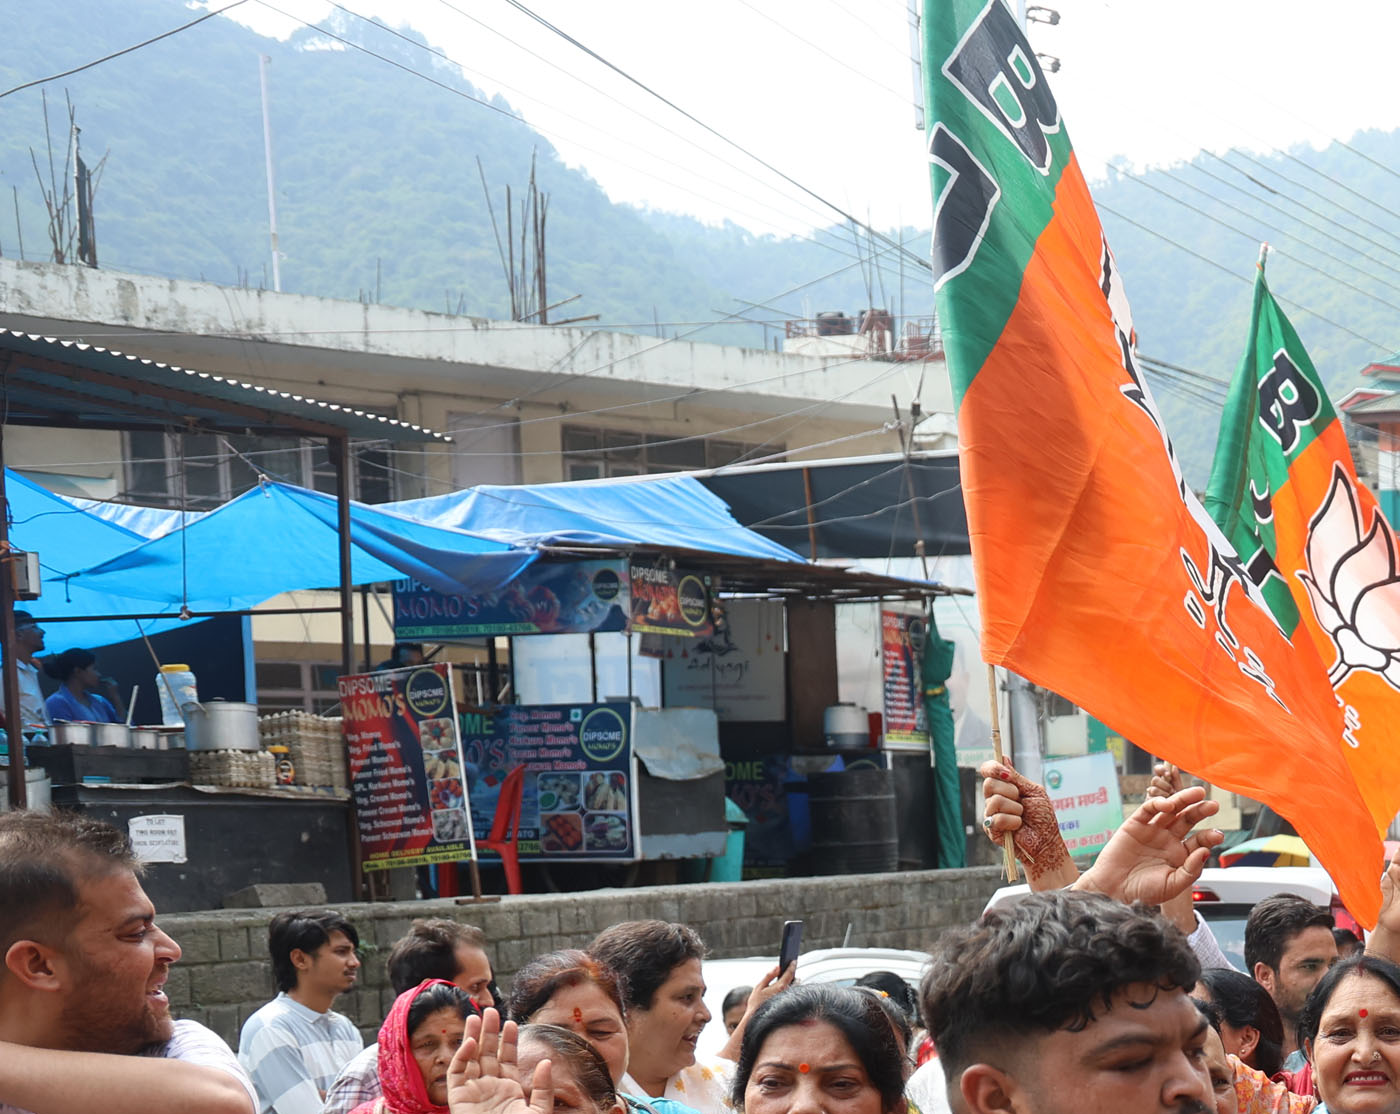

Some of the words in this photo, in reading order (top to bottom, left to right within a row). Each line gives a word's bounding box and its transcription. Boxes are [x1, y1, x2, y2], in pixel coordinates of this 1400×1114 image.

[339, 675, 393, 697] DIPSOME
[343, 693, 407, 722] MOMO'S
[583, 731, 622, 742] DIPSOME
[1077, 785, 1109, 807] मण्डी
